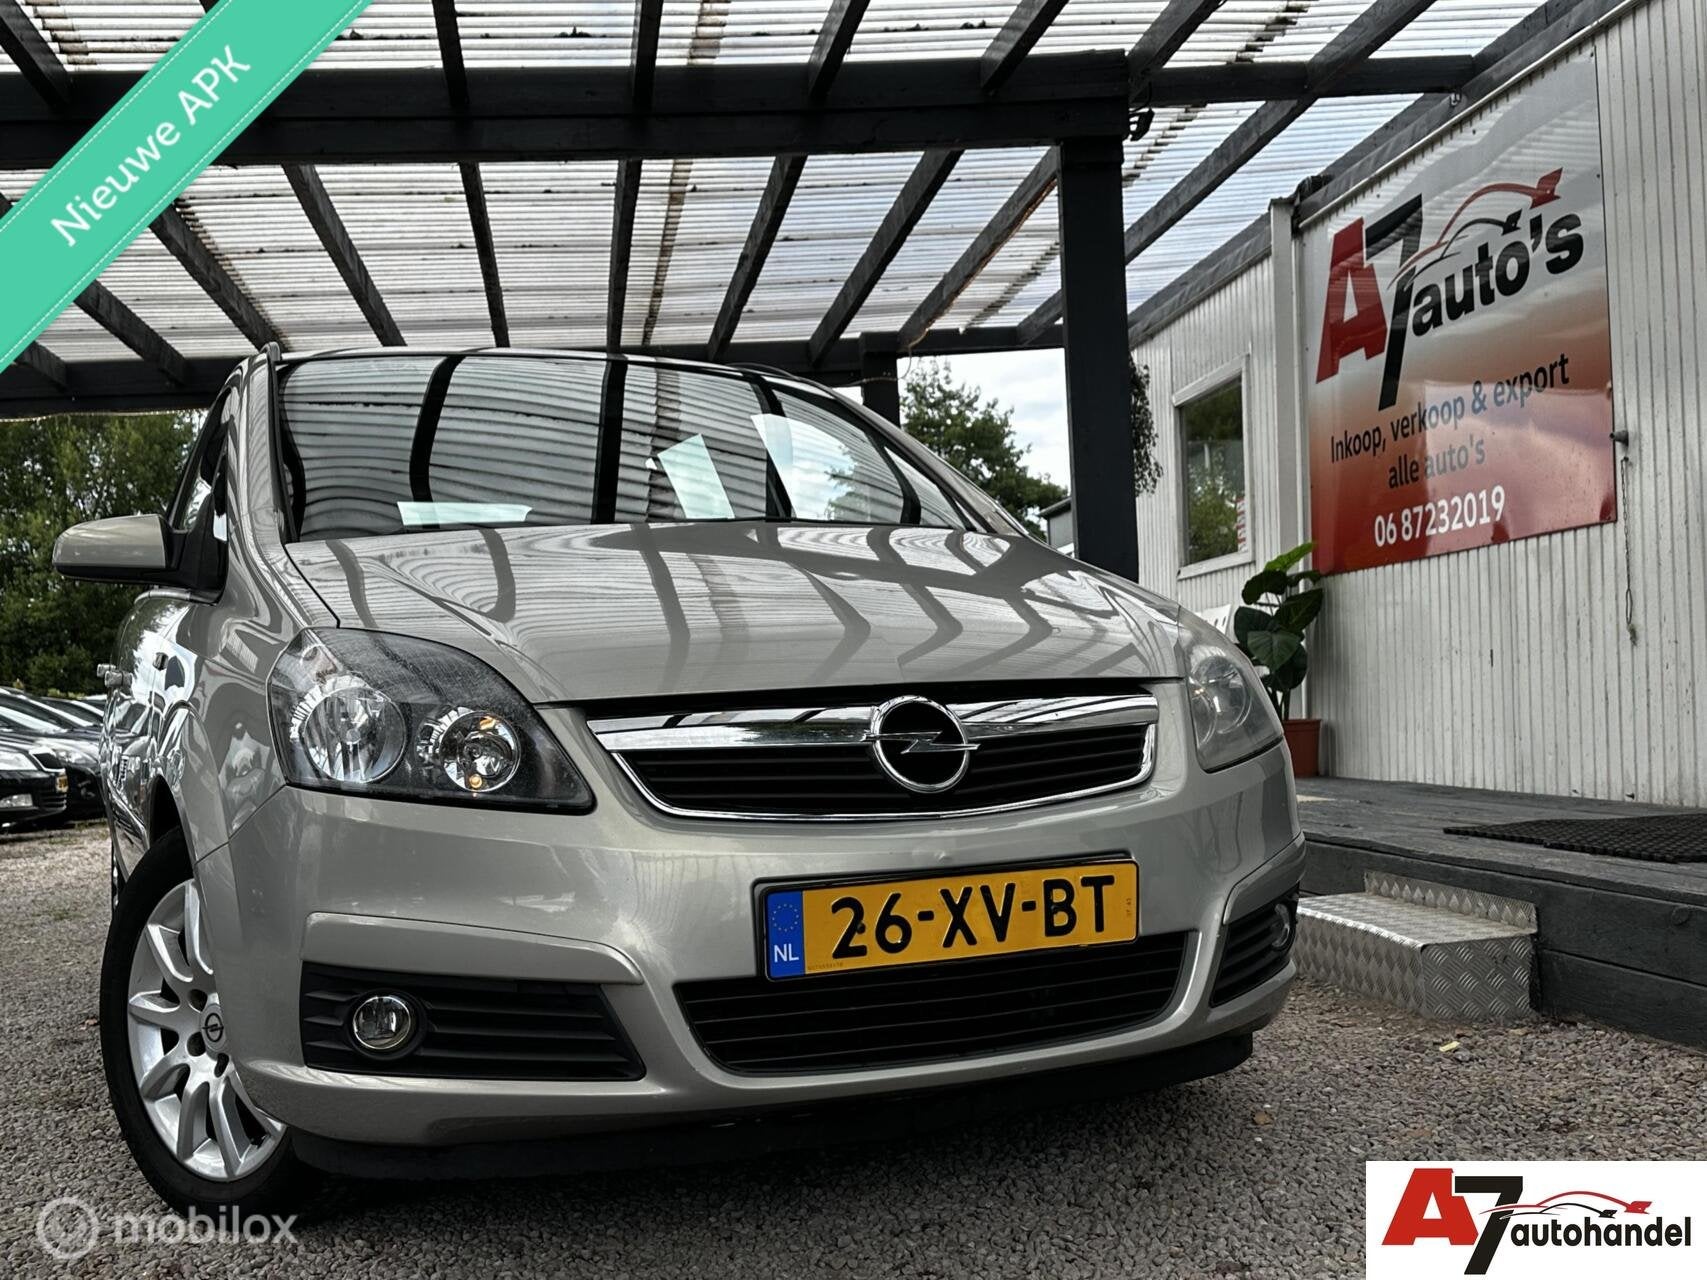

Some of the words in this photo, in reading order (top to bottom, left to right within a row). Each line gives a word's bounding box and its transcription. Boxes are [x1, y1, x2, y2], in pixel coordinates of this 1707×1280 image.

[1315, 193, 1423, 412] A7
[1412, 213, 1585, 337] auto's
[1330, 424, 1387, 463] Inkoop,
[1390, 392, 1466, 442] verkoop
[1472, 380, 1487, 415] &
[1493, 352, 1570, 409] export
[1388, 454, 1420, 489] alle
[1424, 436, 1486, 478] auto's
[1374, 510, 1397, 547] 06
[1401, 484, 1506, 544] 87232019
[773, 943, 800, 964] NL
[830, 874, 1115, 960] 26-XV-BT
